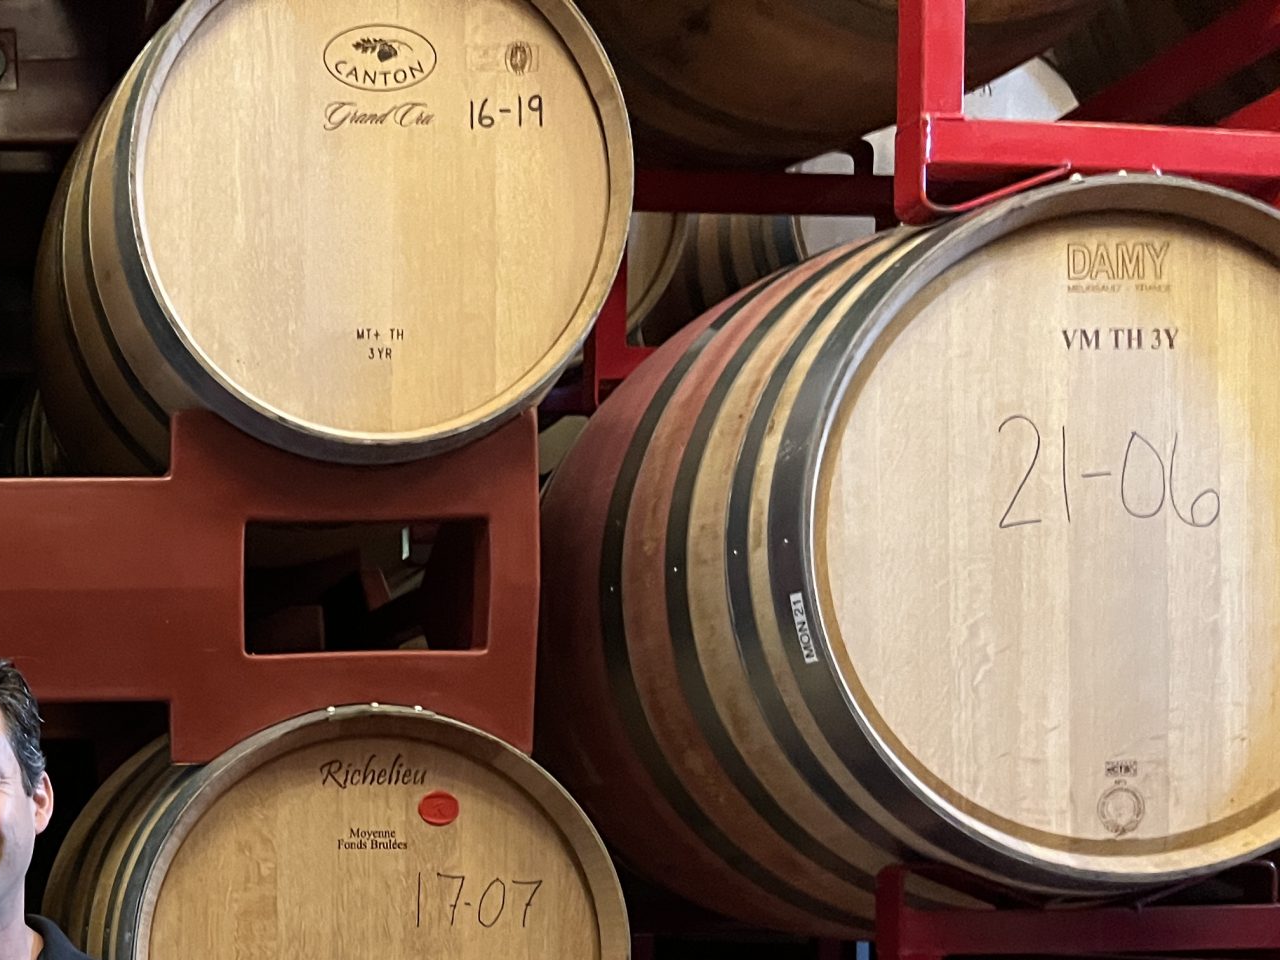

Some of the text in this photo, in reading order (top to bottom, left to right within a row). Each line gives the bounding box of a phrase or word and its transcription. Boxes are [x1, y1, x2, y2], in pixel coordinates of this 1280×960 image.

[334, 60, 425, 87] CANTON
[323, 101, 437, 131] Grand Cru
[469, 93, 544, 131] 16-19
[1067, 241, 1170, 281] DAMY
[390, 328, 404, 341] TH
[1062, 327, 1179, 351] VM TH 3Y
[368, 347, 393, 360] 3YR
[998, 415, 1220, 528] 21-06
[319, 753, 428, 790] Richelieu
[337, 839, 368, 850] Fonds
[349, 827, 396, 841] Moyenne
[417, 871, 543, 928] 17-07
